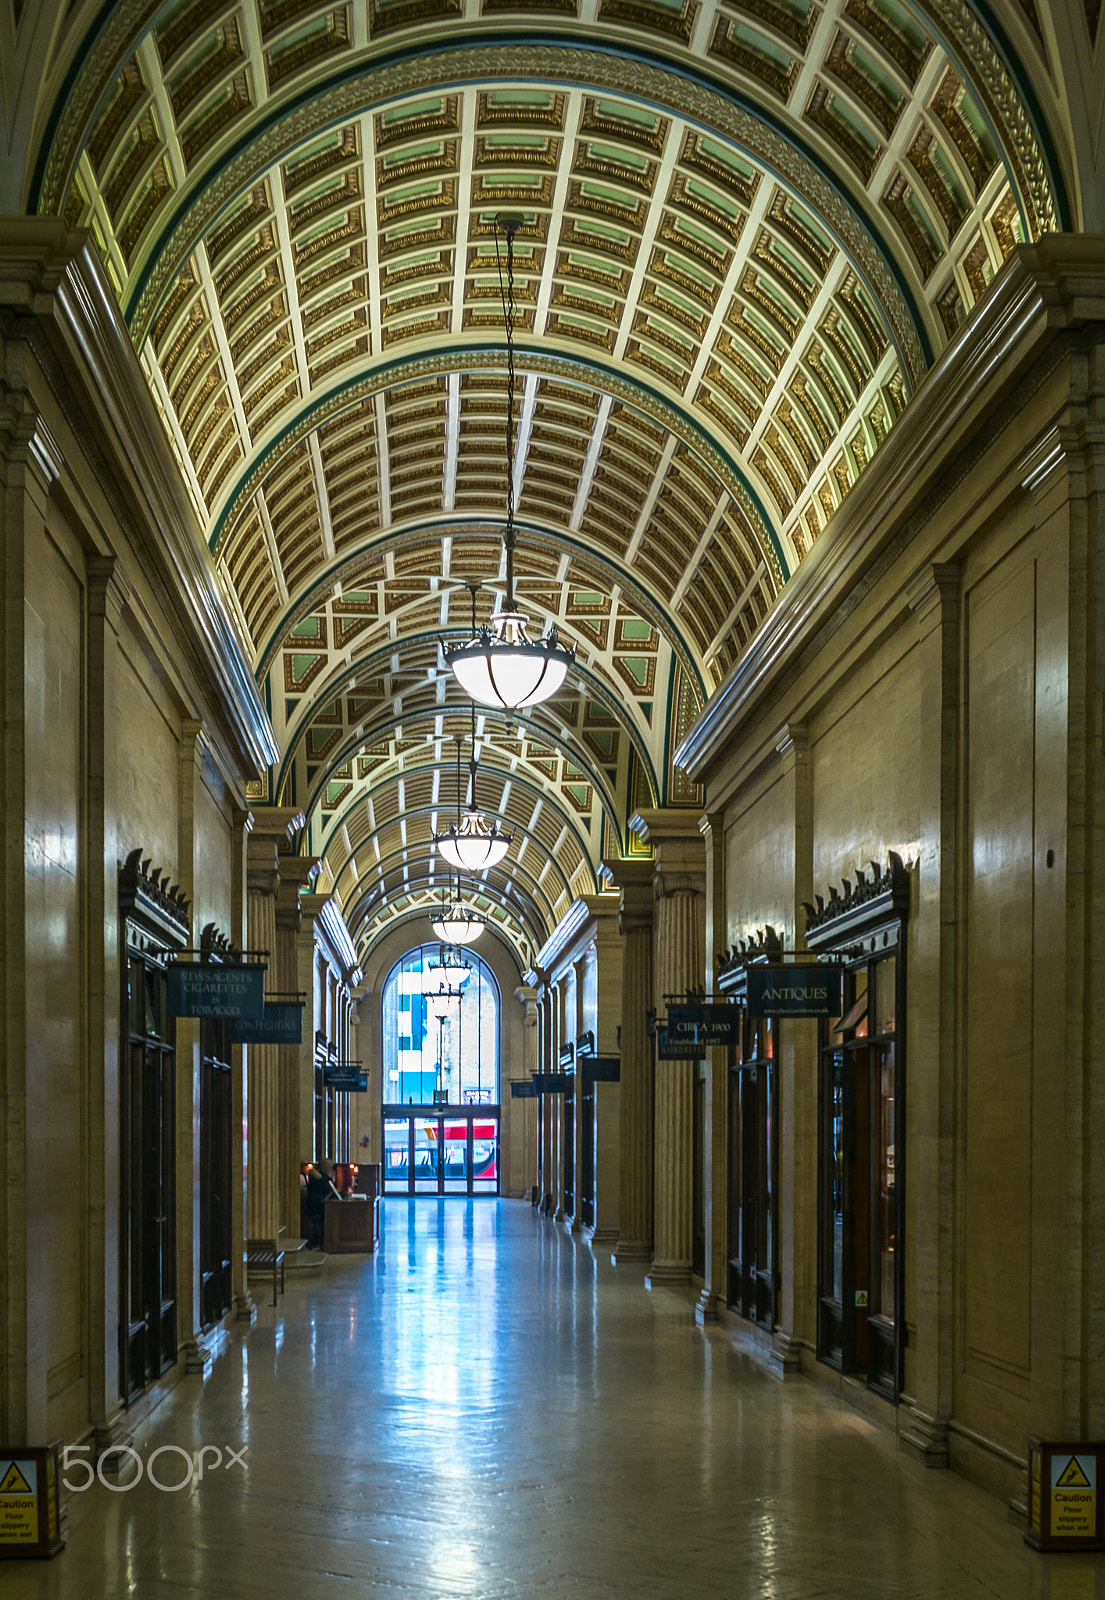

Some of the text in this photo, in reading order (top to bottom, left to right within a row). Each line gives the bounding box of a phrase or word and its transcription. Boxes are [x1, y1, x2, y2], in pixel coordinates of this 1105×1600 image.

[181, 971, 252, 983] NEWSAGENTS
[183, 983, 248, 993] CIGARETTES
[761, 987, 828, 1001] ANTIQUES
[211, 996, 219, 1004] &
[191, 1005, 240, 1016] TOBACCO
[676, 1022, 731, 1032] CIRCA 1900
[1054, 1493, 1092, 1502] Caution
